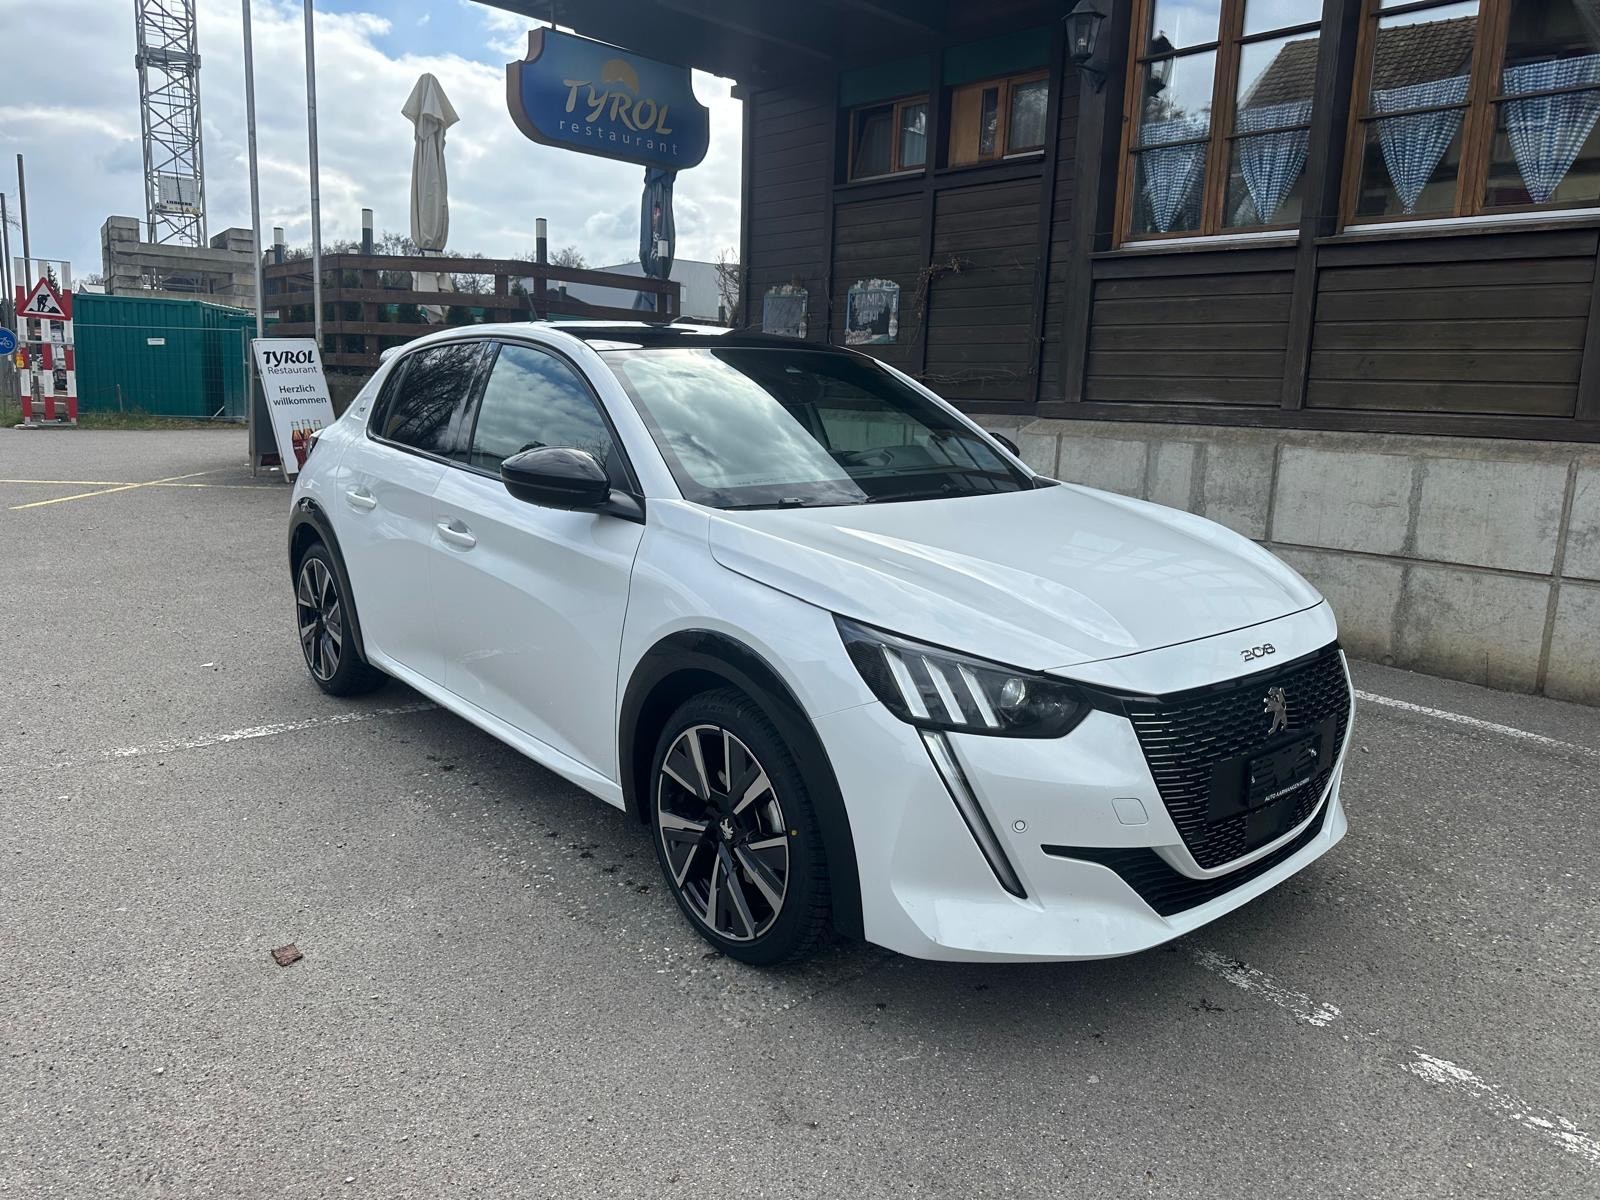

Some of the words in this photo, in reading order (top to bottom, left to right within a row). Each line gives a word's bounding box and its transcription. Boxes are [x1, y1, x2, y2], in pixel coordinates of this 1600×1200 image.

[563, 79, 673, 135] TYROL
[559, 119, 678, 155] restaurant
[263, 350, 315, 367] TYROL
[267, 365, 318, 375] Restaurant
[279, 384, 316, 394] Herzlich
[273, 396, 327, 406] willkommen
[1239, 643, 1276, 663] 208
